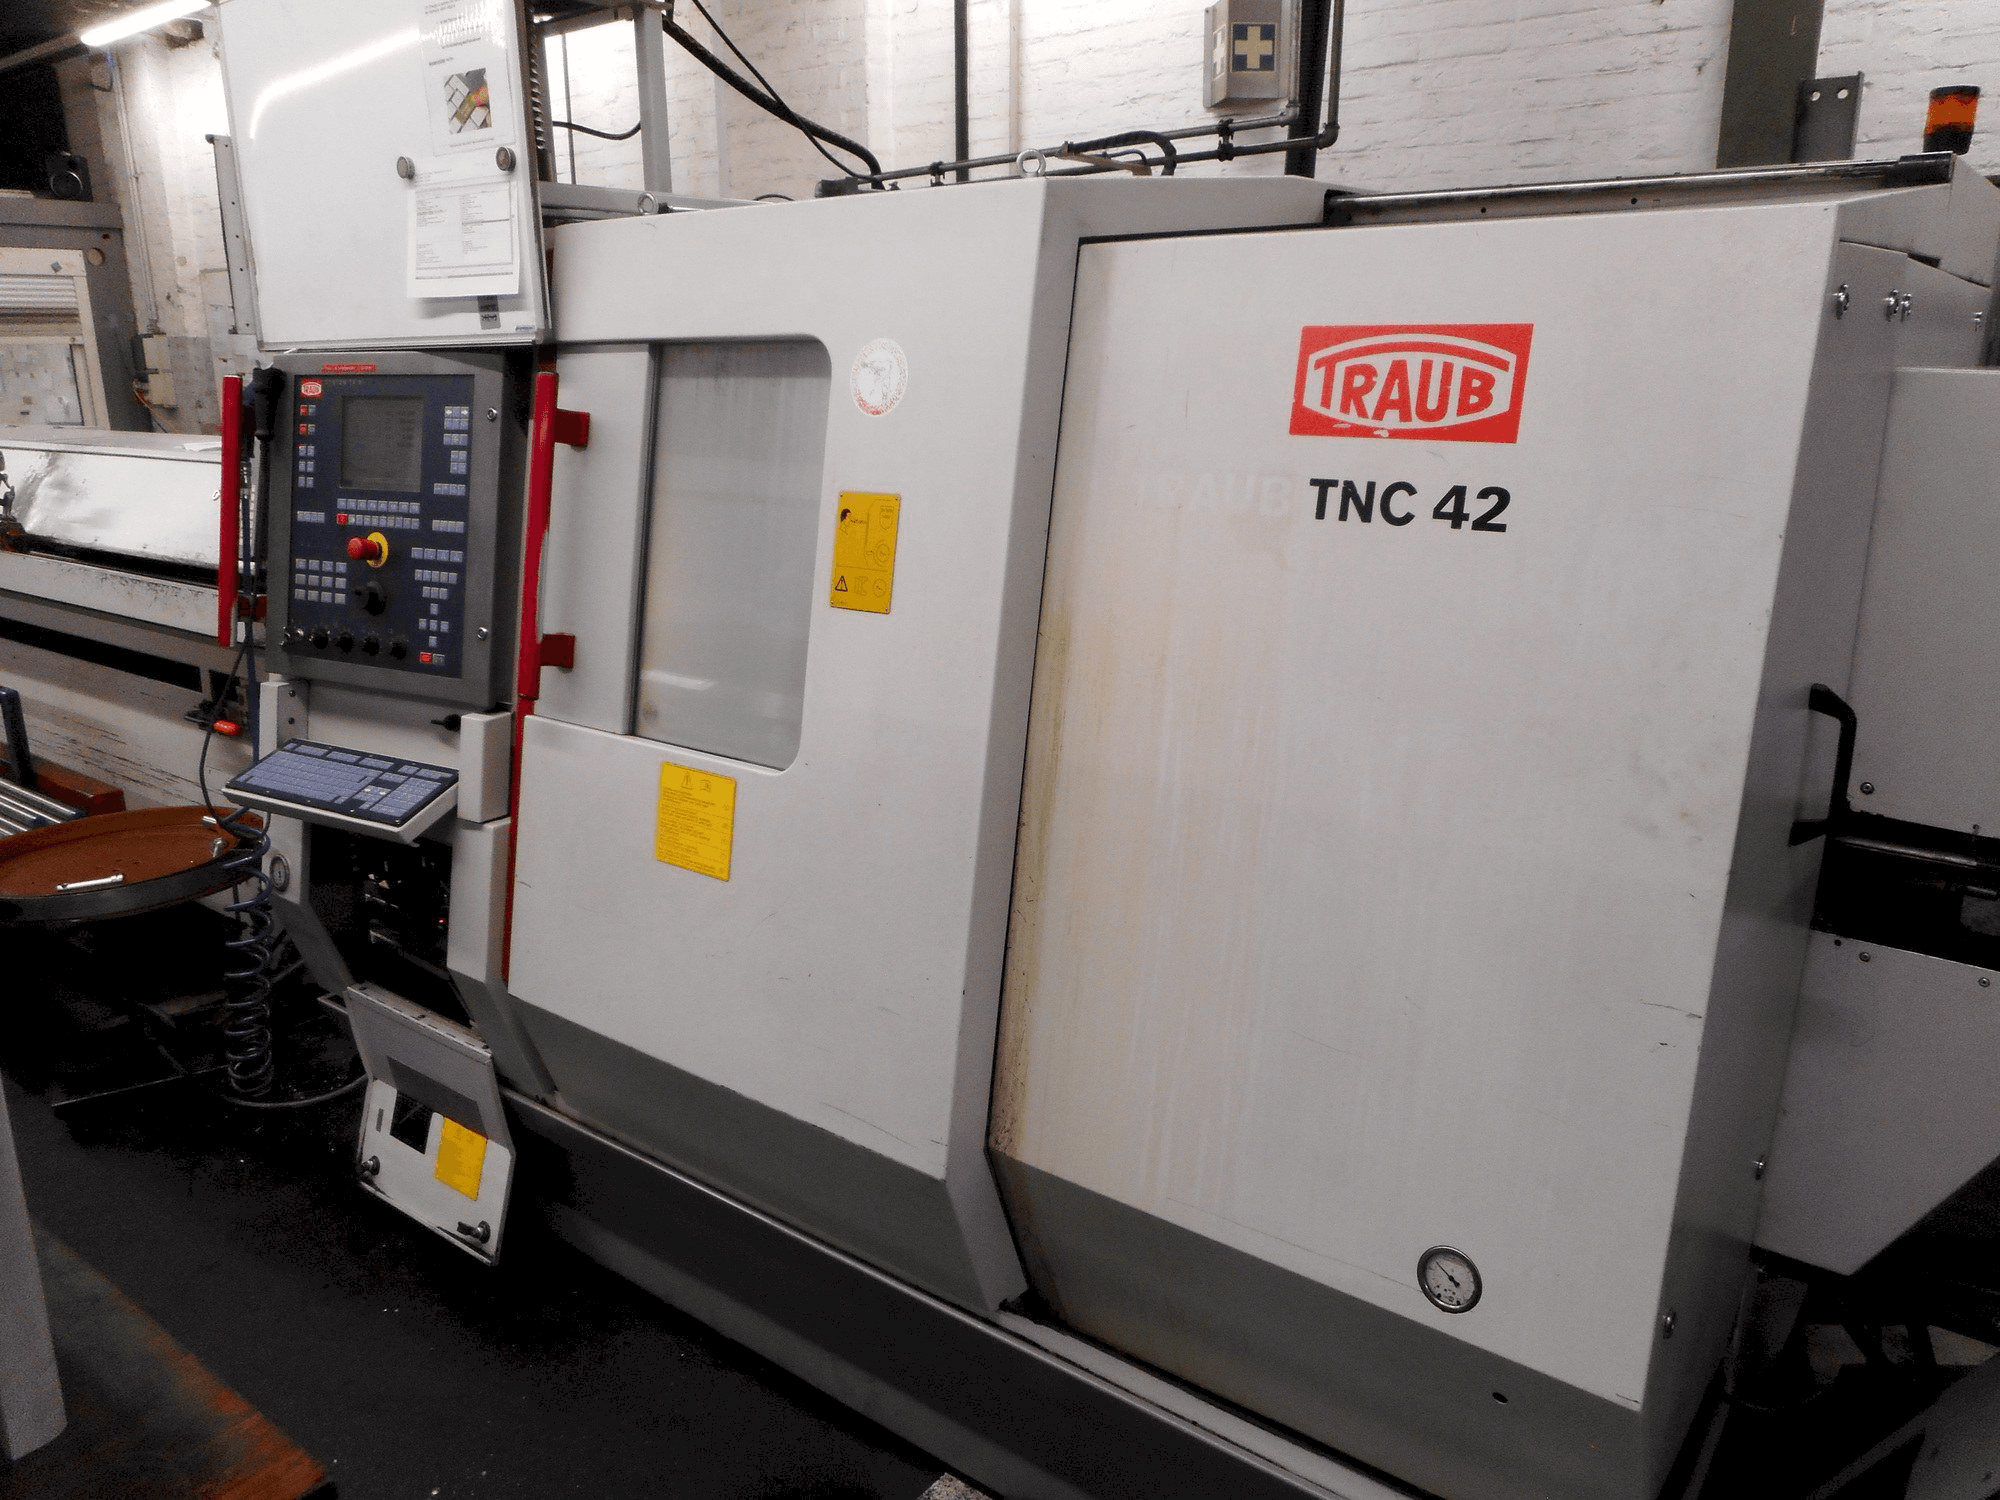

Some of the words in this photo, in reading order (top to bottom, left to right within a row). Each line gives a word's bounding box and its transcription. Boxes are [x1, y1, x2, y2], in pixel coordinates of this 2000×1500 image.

[1314, 341, 1510, 423] TRAUB
[1309, 478, 1418, 526] TNC
[1432, 484, 1511, 532] 42
